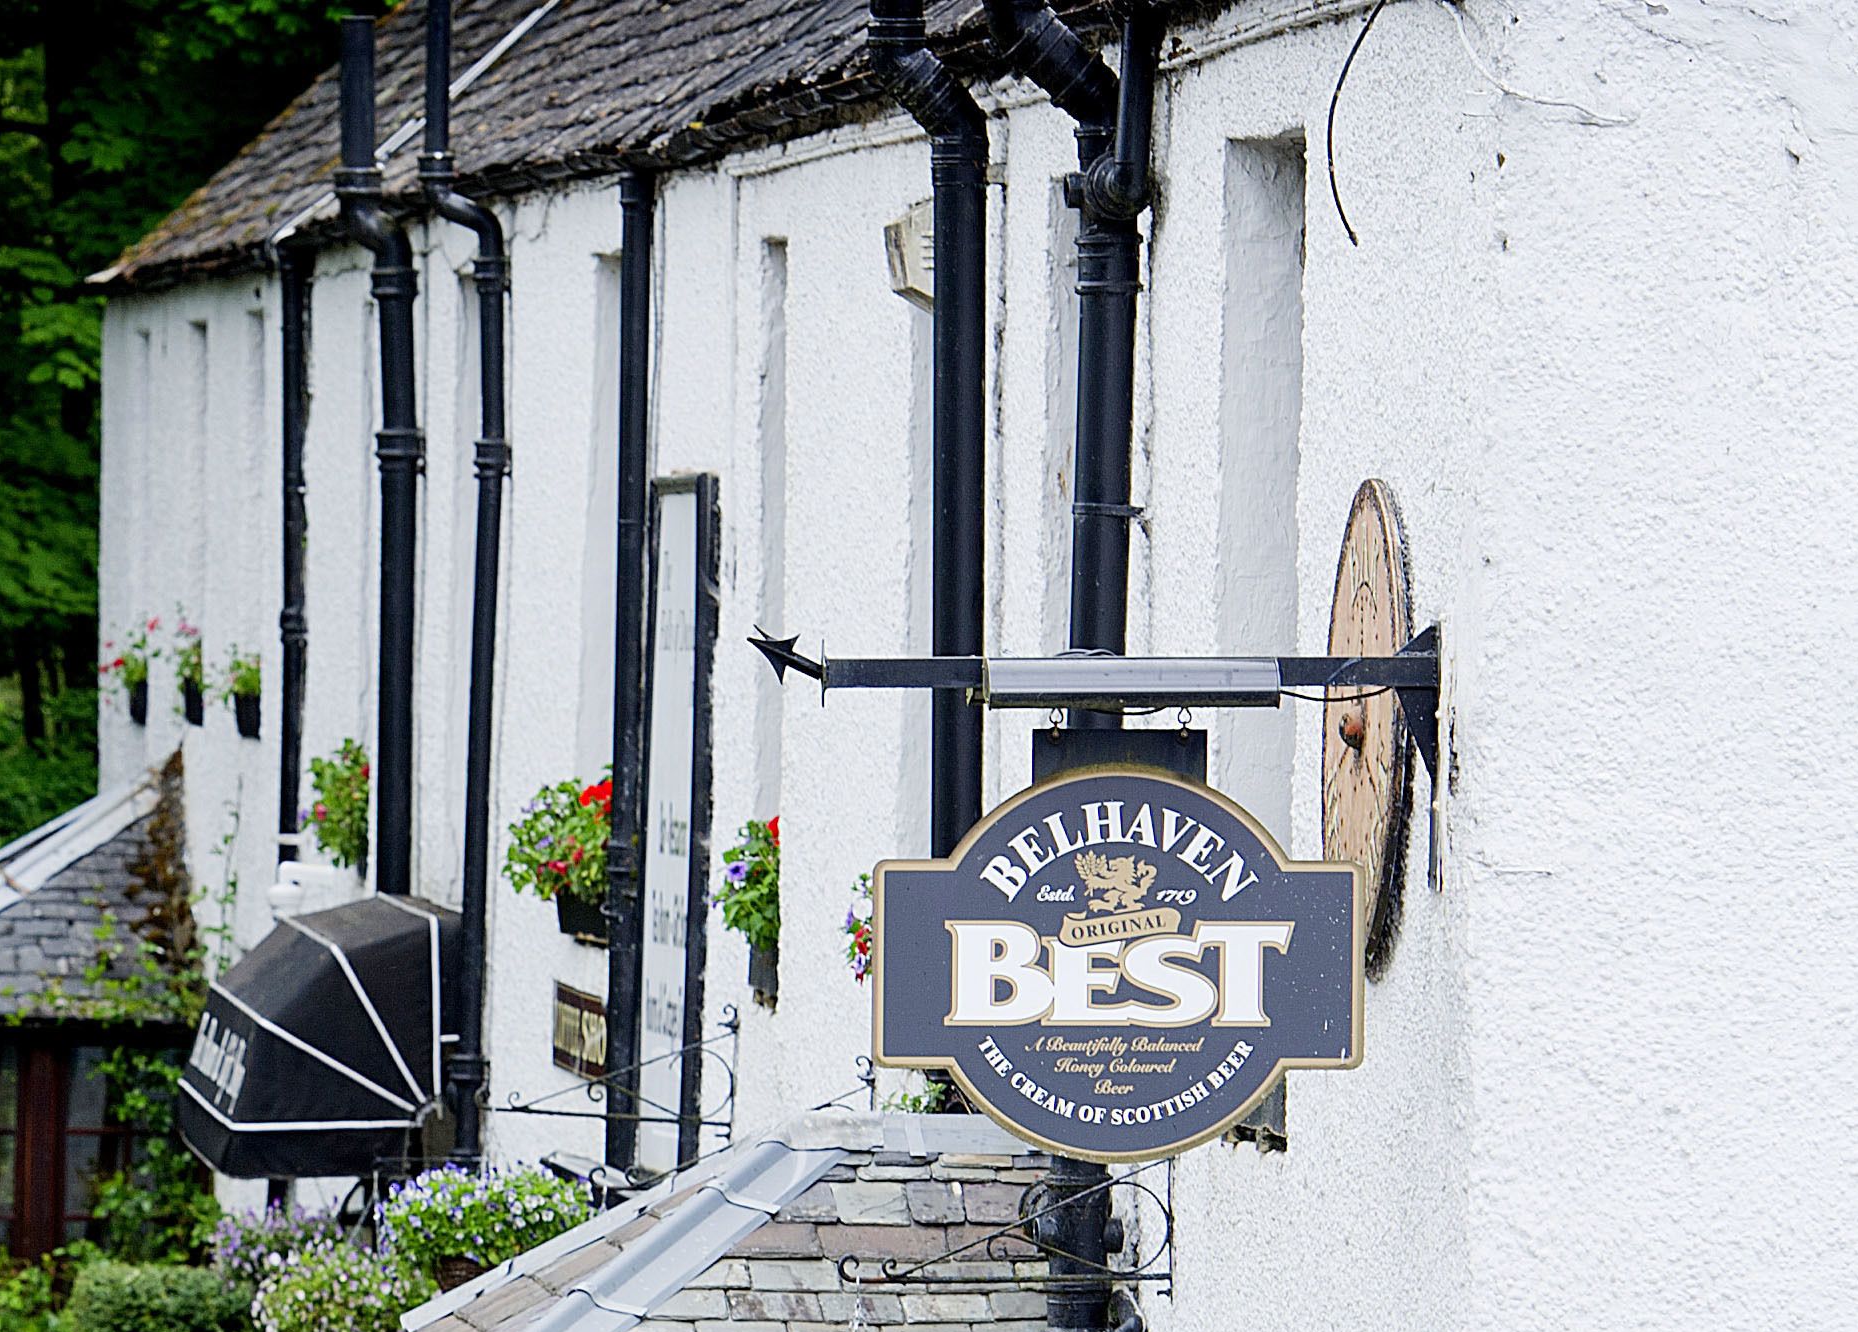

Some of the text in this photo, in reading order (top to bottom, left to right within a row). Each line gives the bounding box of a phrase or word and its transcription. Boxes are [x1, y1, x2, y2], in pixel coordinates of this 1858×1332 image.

[980, 801, 1259, 902] BELHAVEN
[1036, 884, 1198, 905] Estd. 1719
[1071, 913, 1168, 941] ORIGINAL
[943, 920, 1295, 1028] BEST
[1025, 1036, 1205, 1055] A Beautifully Balanced
[978, 1035, 1255, 1125] THE CREAM OF SCOTTISH BEER
[1054, 1057, 1177, 1079] Honey Coloured
[1094, 1079, 1135, 1095] Beer
